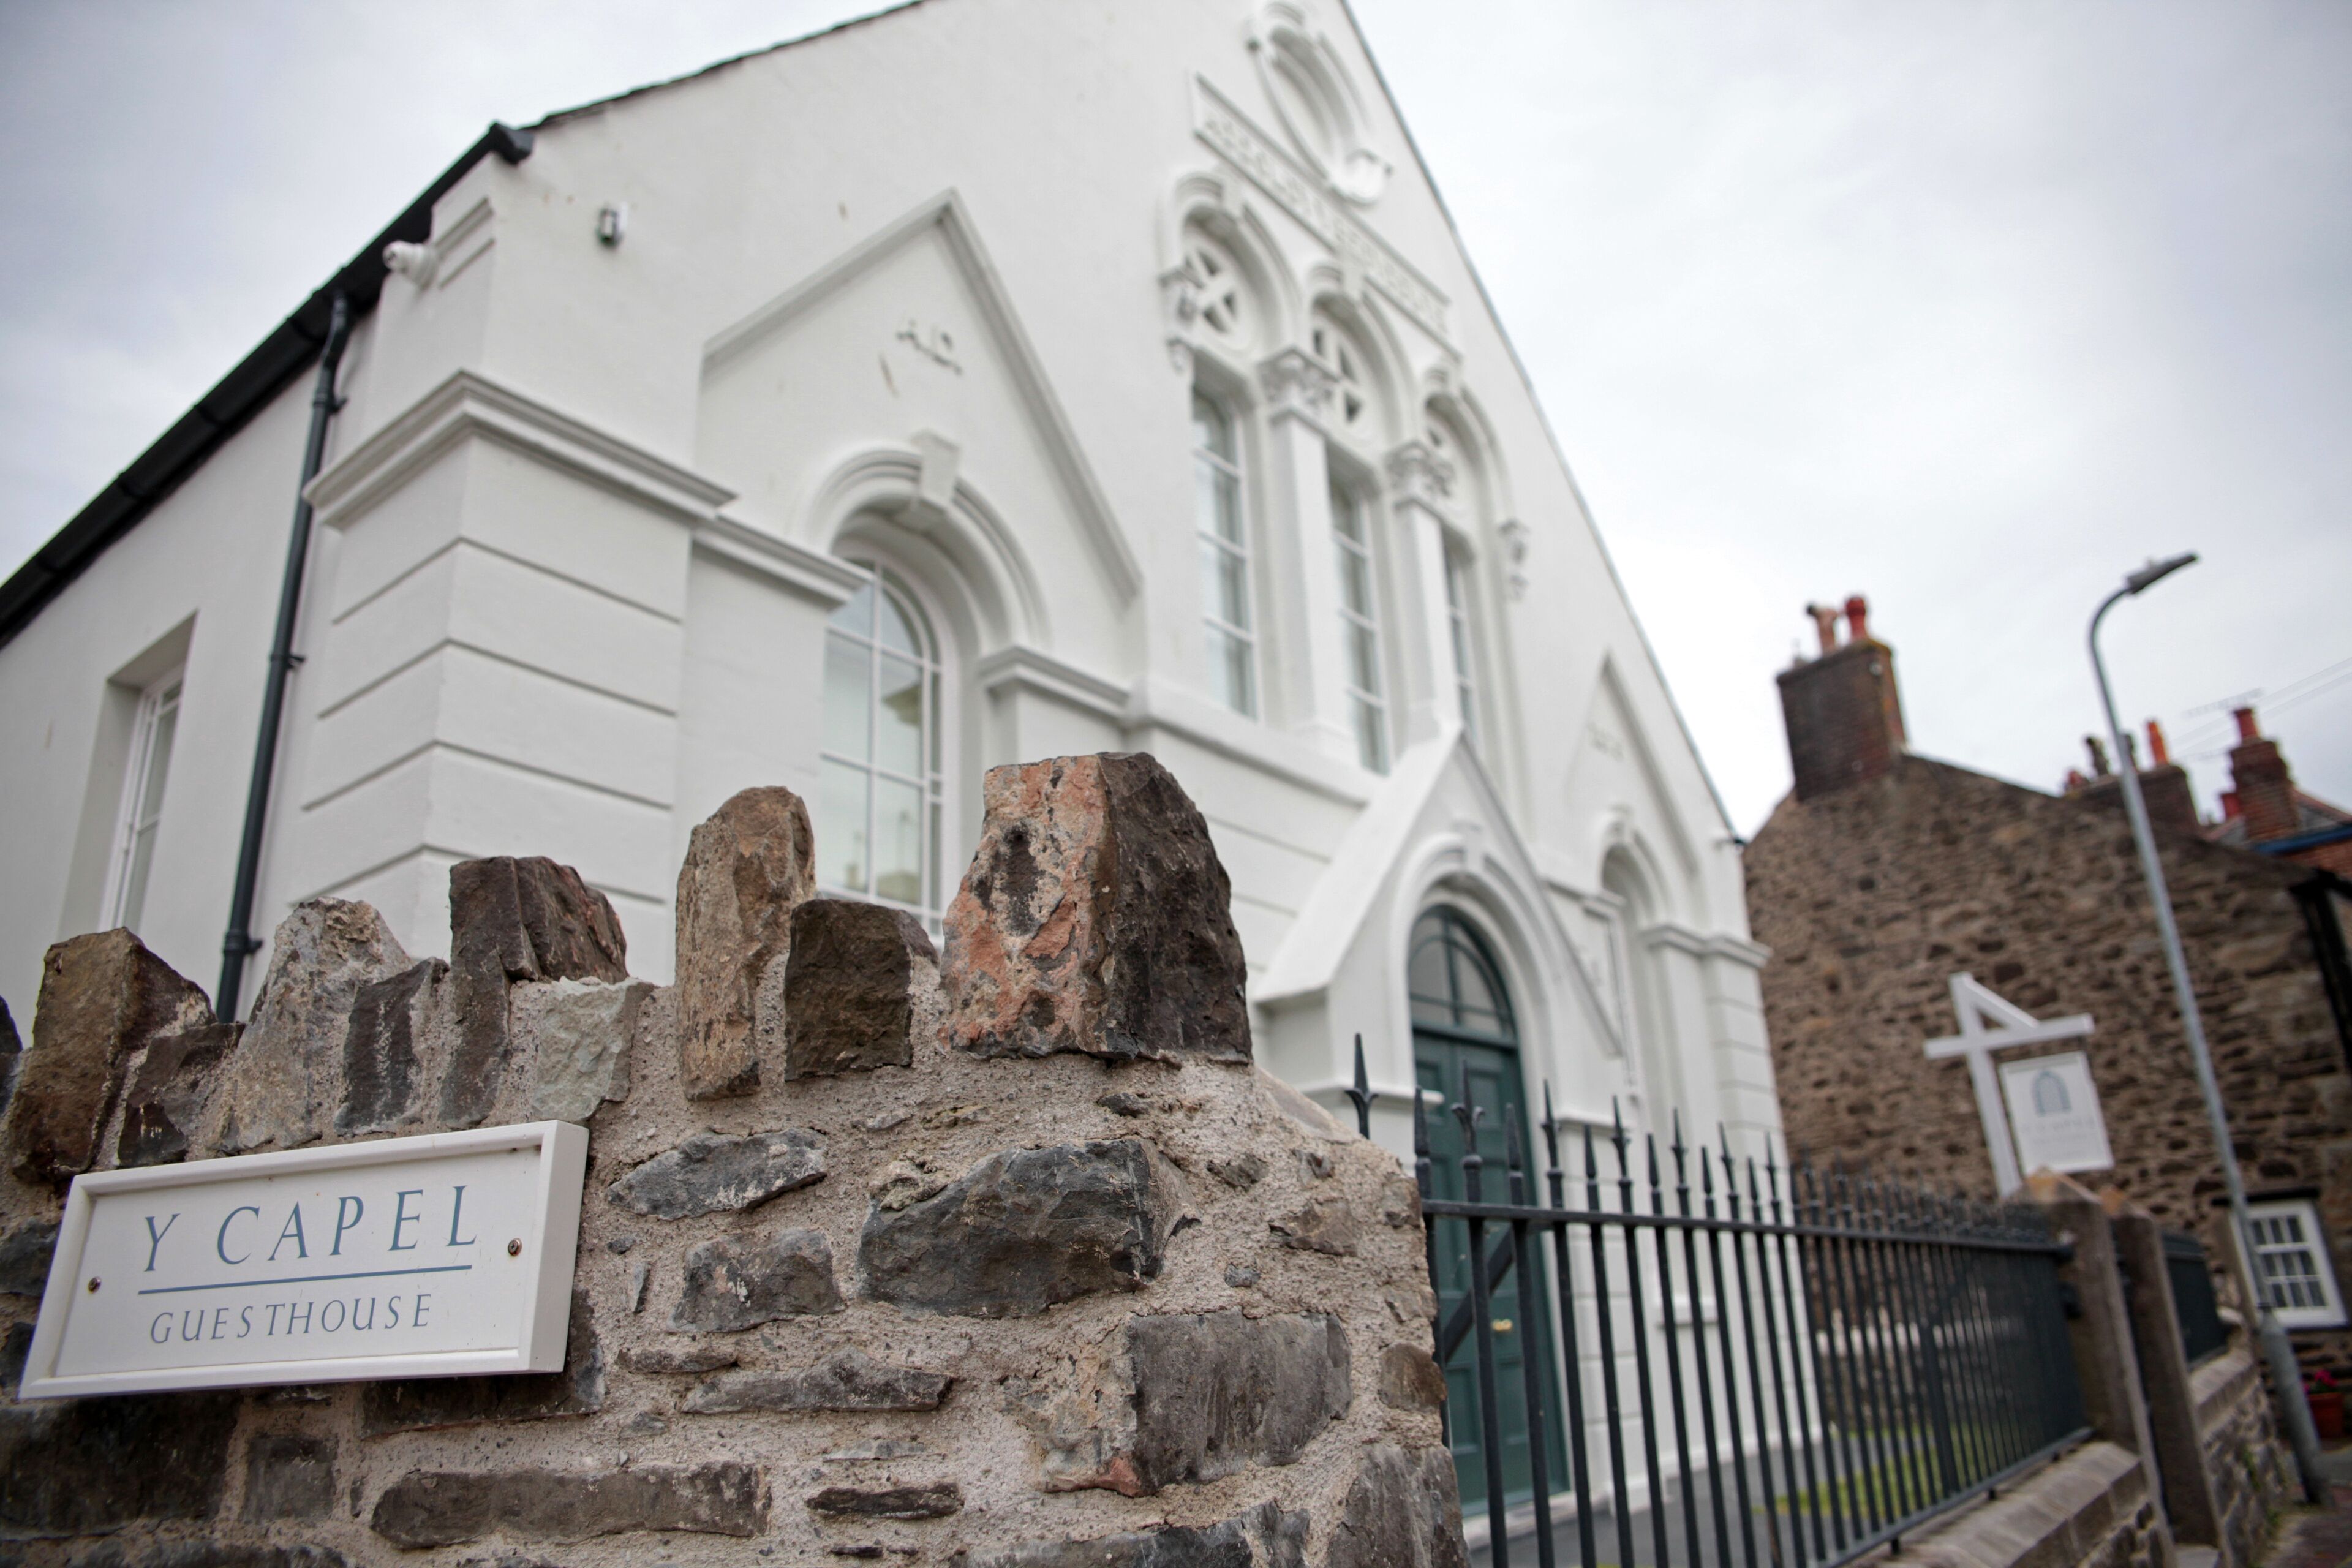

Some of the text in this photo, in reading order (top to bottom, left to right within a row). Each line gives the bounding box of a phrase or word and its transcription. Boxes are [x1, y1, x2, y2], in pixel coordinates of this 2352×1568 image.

[143, 1185, 477, 1272] Y CAPEL
[150, 1294, 431, 1344] GUESTHOUSE
